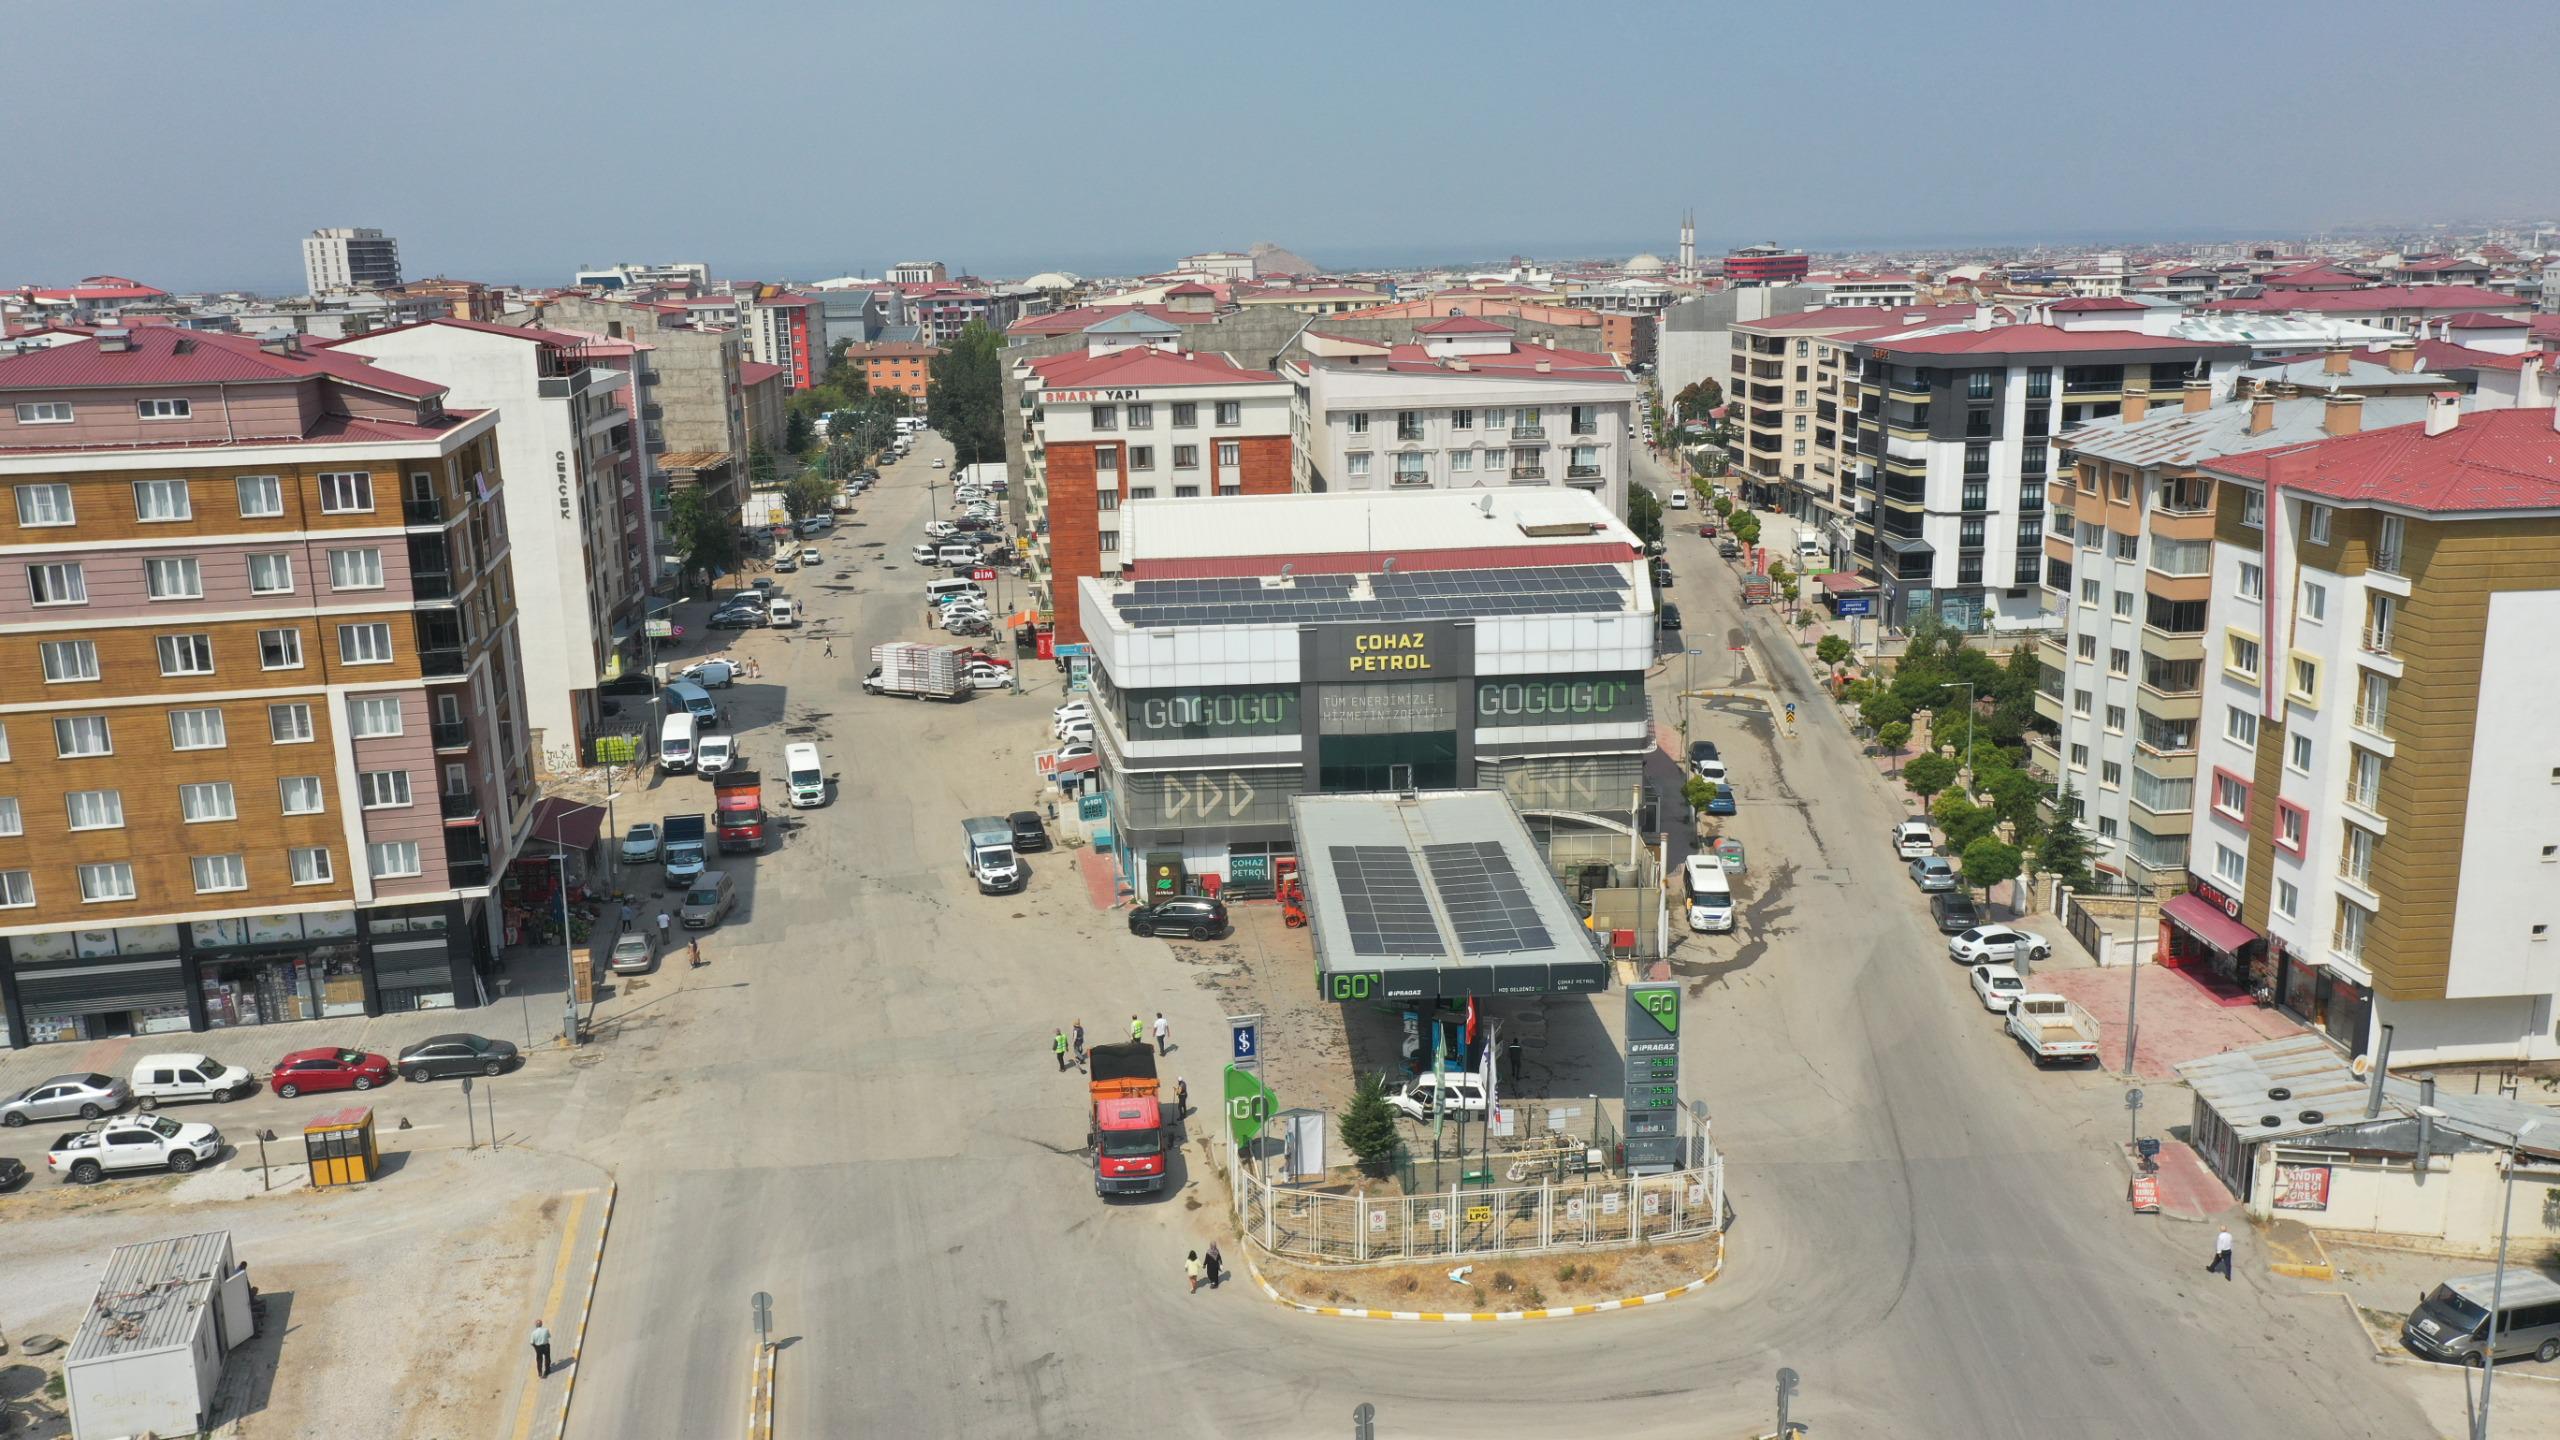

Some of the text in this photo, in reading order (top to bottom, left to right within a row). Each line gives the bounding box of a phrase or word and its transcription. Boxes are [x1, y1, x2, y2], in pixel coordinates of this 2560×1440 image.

[1046, 389, 1139, 403] SMART YAPI
[1356, 632, 1425, 653] ÇOHAZ
[1349, 654, 1431, 672] PETROL
[1480, 682, 1614, 715] GOGOGO
[1231, 858, 1264, 869] ÇOHAZ
[1232, 868, 1267, 877] PETROL
[1333, 974, 1369, 999] GO
[1648, 994, 1674, 1015] GO
[1233, 1094, 1268, 1123] GO
[1469, 1212, 1488, 1220] LPG
